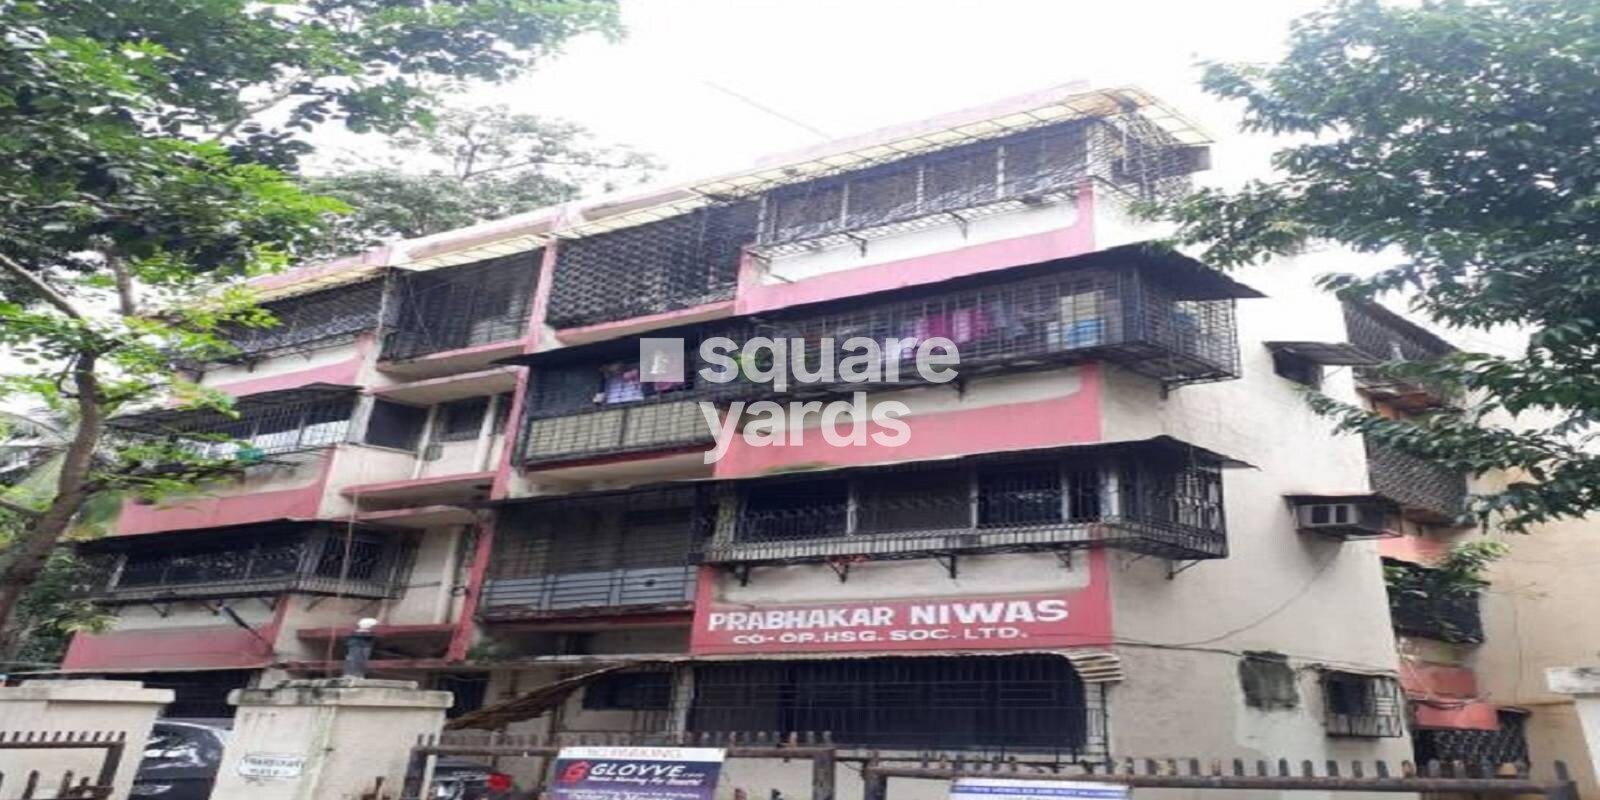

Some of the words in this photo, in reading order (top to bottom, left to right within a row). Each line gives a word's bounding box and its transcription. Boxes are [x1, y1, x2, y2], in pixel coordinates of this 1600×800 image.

[707, 607, 895, 631] PRABHAKAR
[910, 599, 1068, 625] NIWAS
[964, 626, 1028, 639] LTD.
